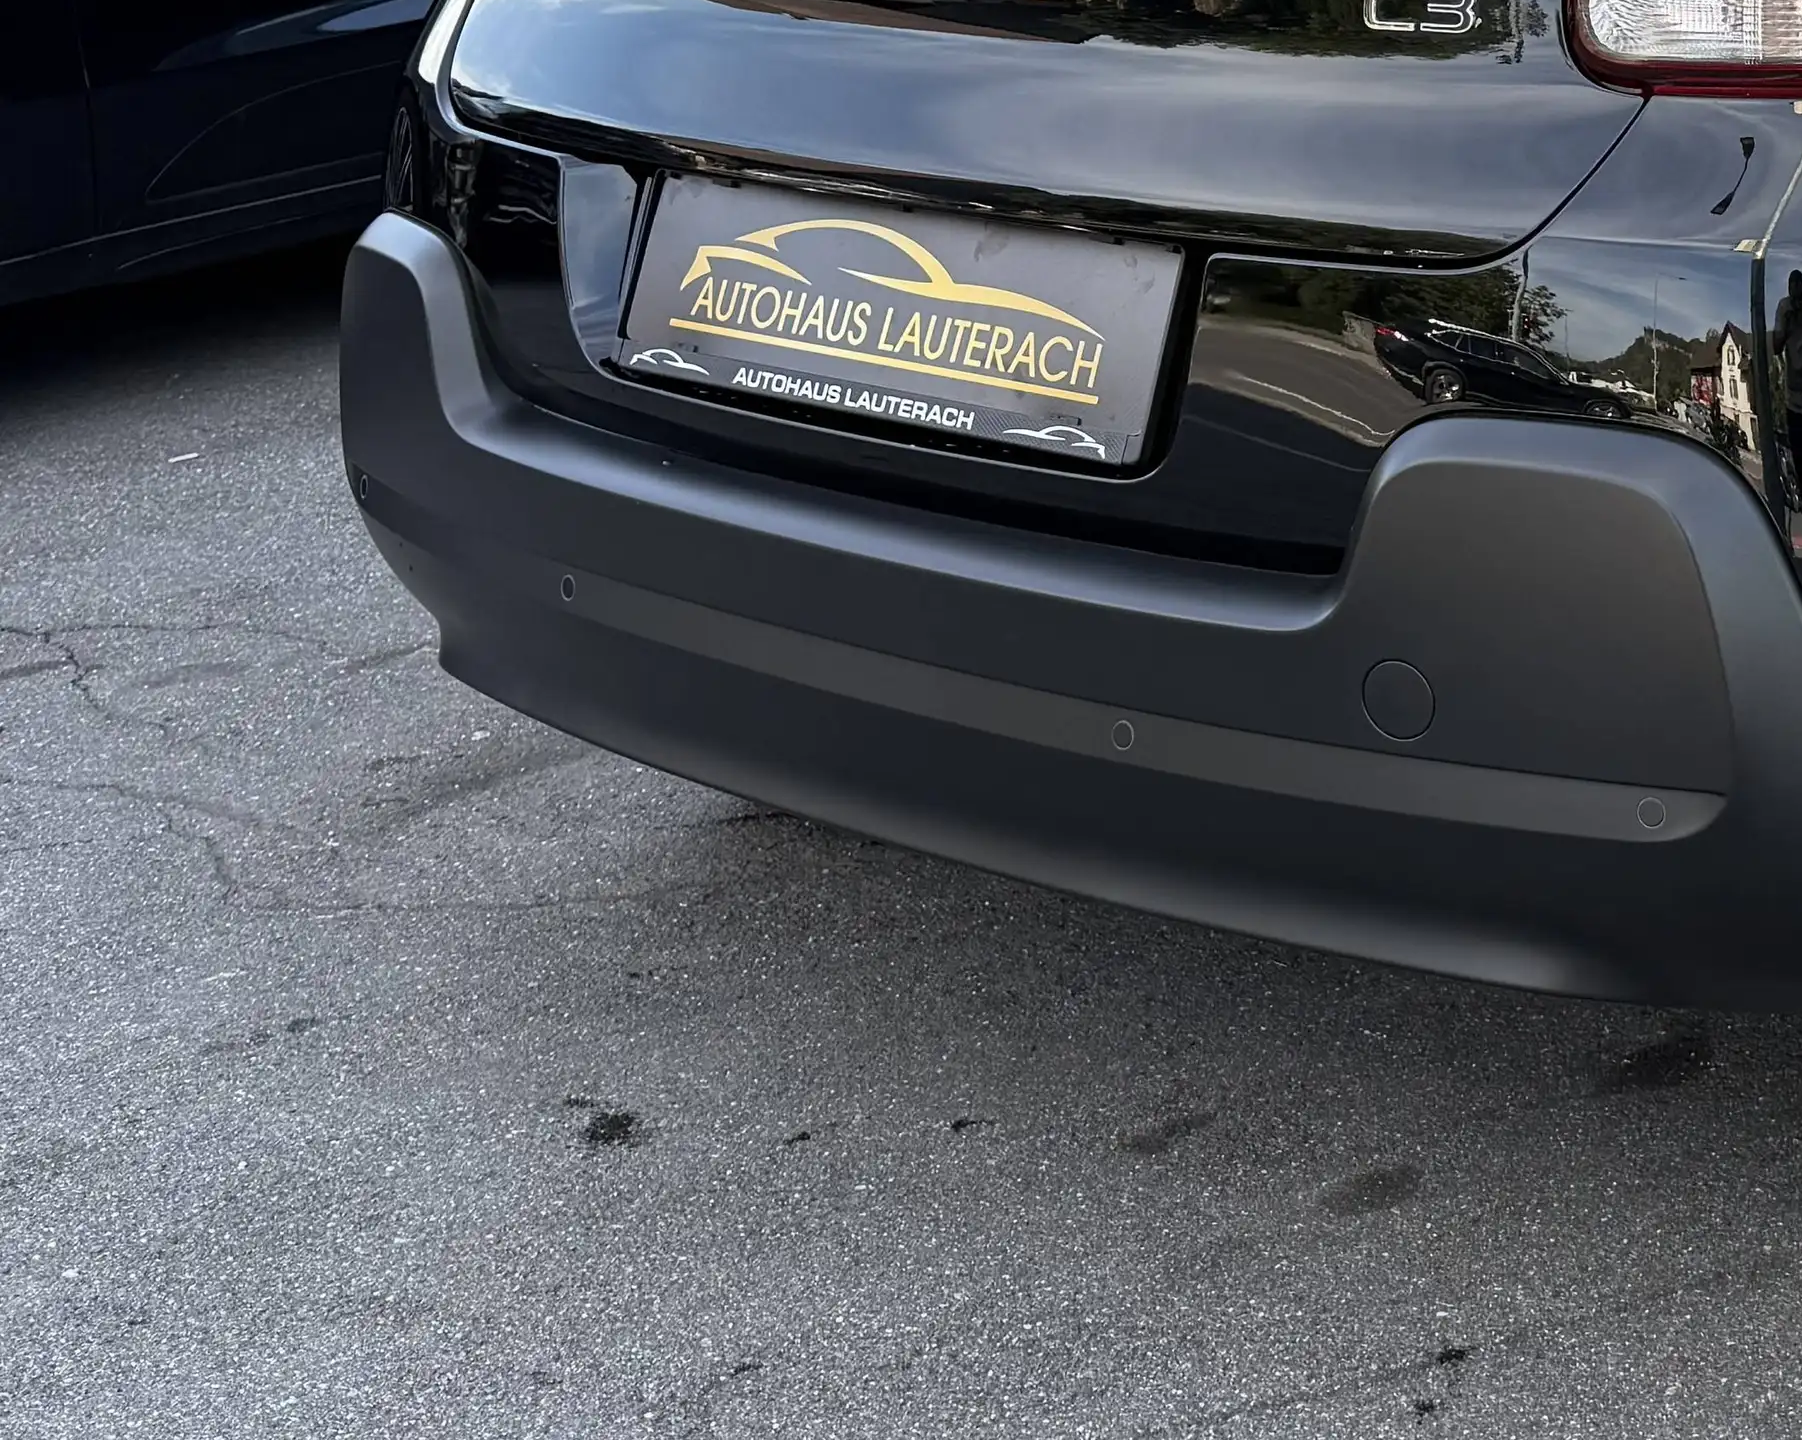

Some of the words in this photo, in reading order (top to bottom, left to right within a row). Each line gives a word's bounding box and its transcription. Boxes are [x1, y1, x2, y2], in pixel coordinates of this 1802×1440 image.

[690, 276, 872, 347] AUTOHAUS
[877, 306, 1104, 389] LAUTERACH
[732, 367, 841, 404] AUTOHAUS
[843, 388, 975, 430] LAUTERACH
